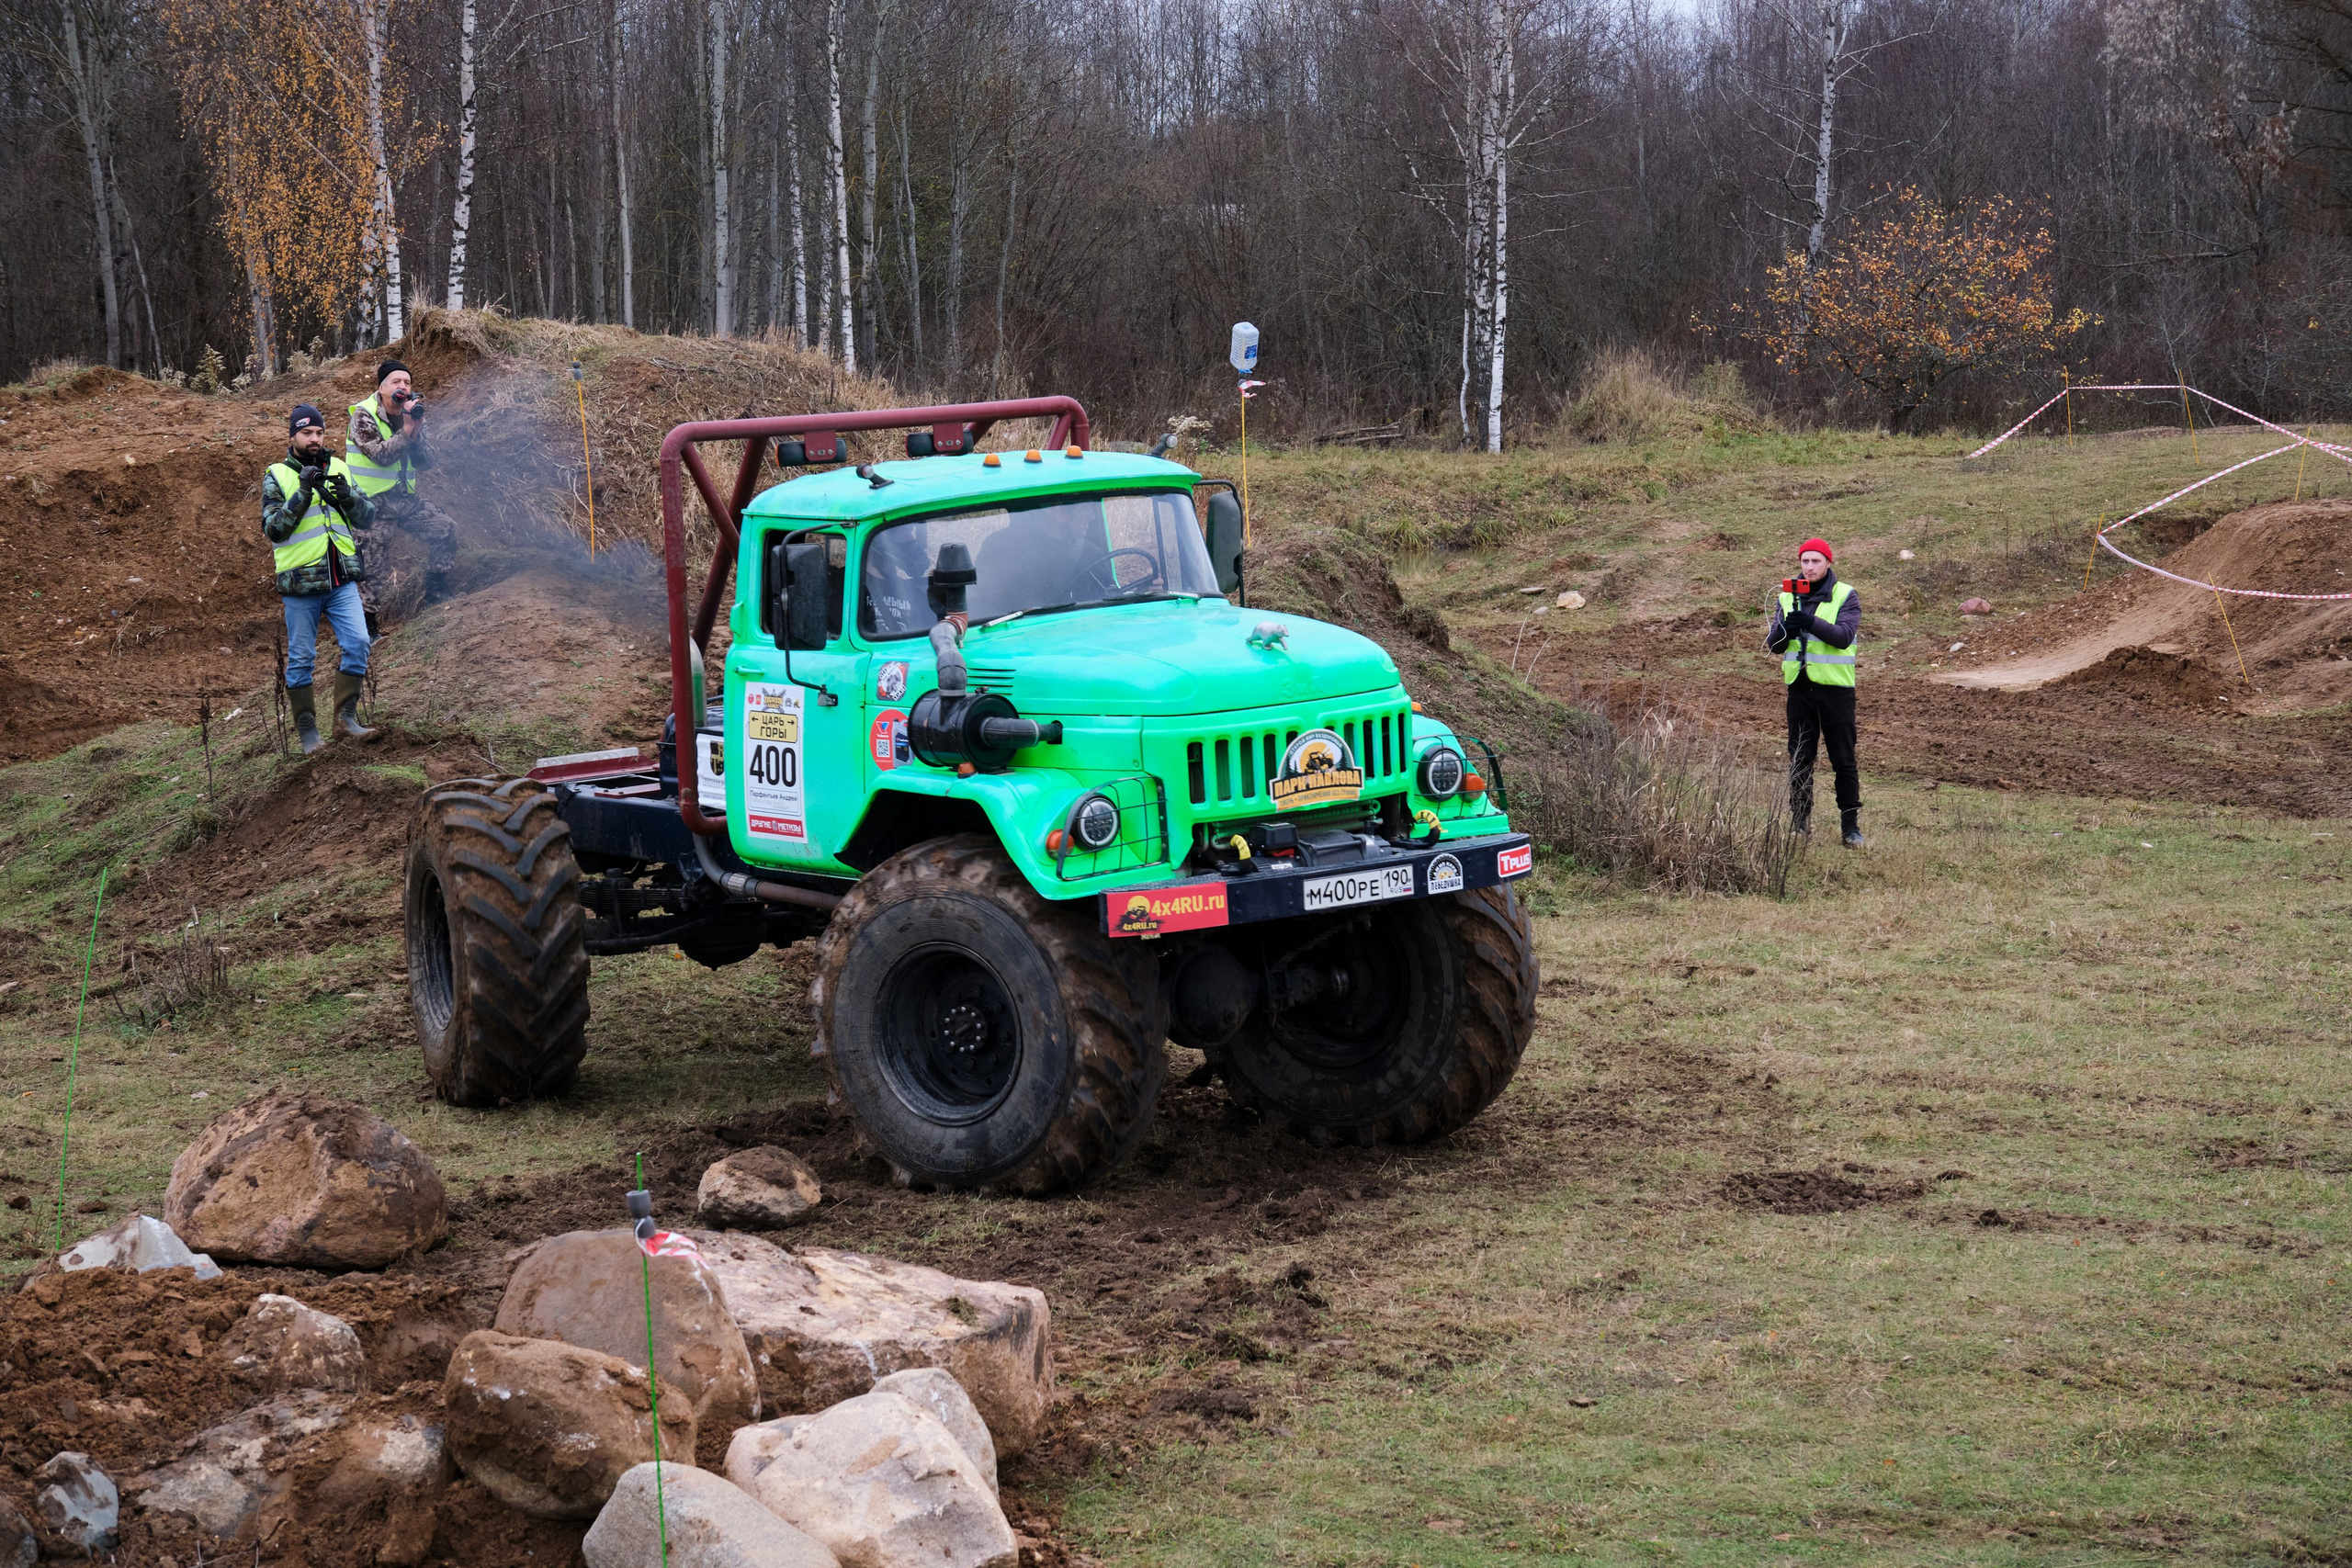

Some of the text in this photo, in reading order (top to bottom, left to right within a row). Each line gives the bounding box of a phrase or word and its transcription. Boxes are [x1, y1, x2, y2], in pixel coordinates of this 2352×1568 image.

[762, 715, 785, 727] ЦАРЬ
[760, 727, 786, 739] ГОРЫ
[750, 744, 797, 787] 400
[1273, 770, 1361, 797] ПАРК ПАВЛОВА
[750, 789, 797, 802] Парфентьев Андрей
[751, 819, 802, 832] ДРУГИЕ МЕТИЗЫ
[1500, 853, 1531, 872] TPLUS
[1384, 869, 1408, 887] 190
[1430, 877, 1461, 891] ЛЕБЕДУШКА
[1389, 886, 1403, 895] RUS
[1151, 895, 1225, 917] 4x4RU.ru
[1122, 921, 1158, 931] 4x4RU.ru
